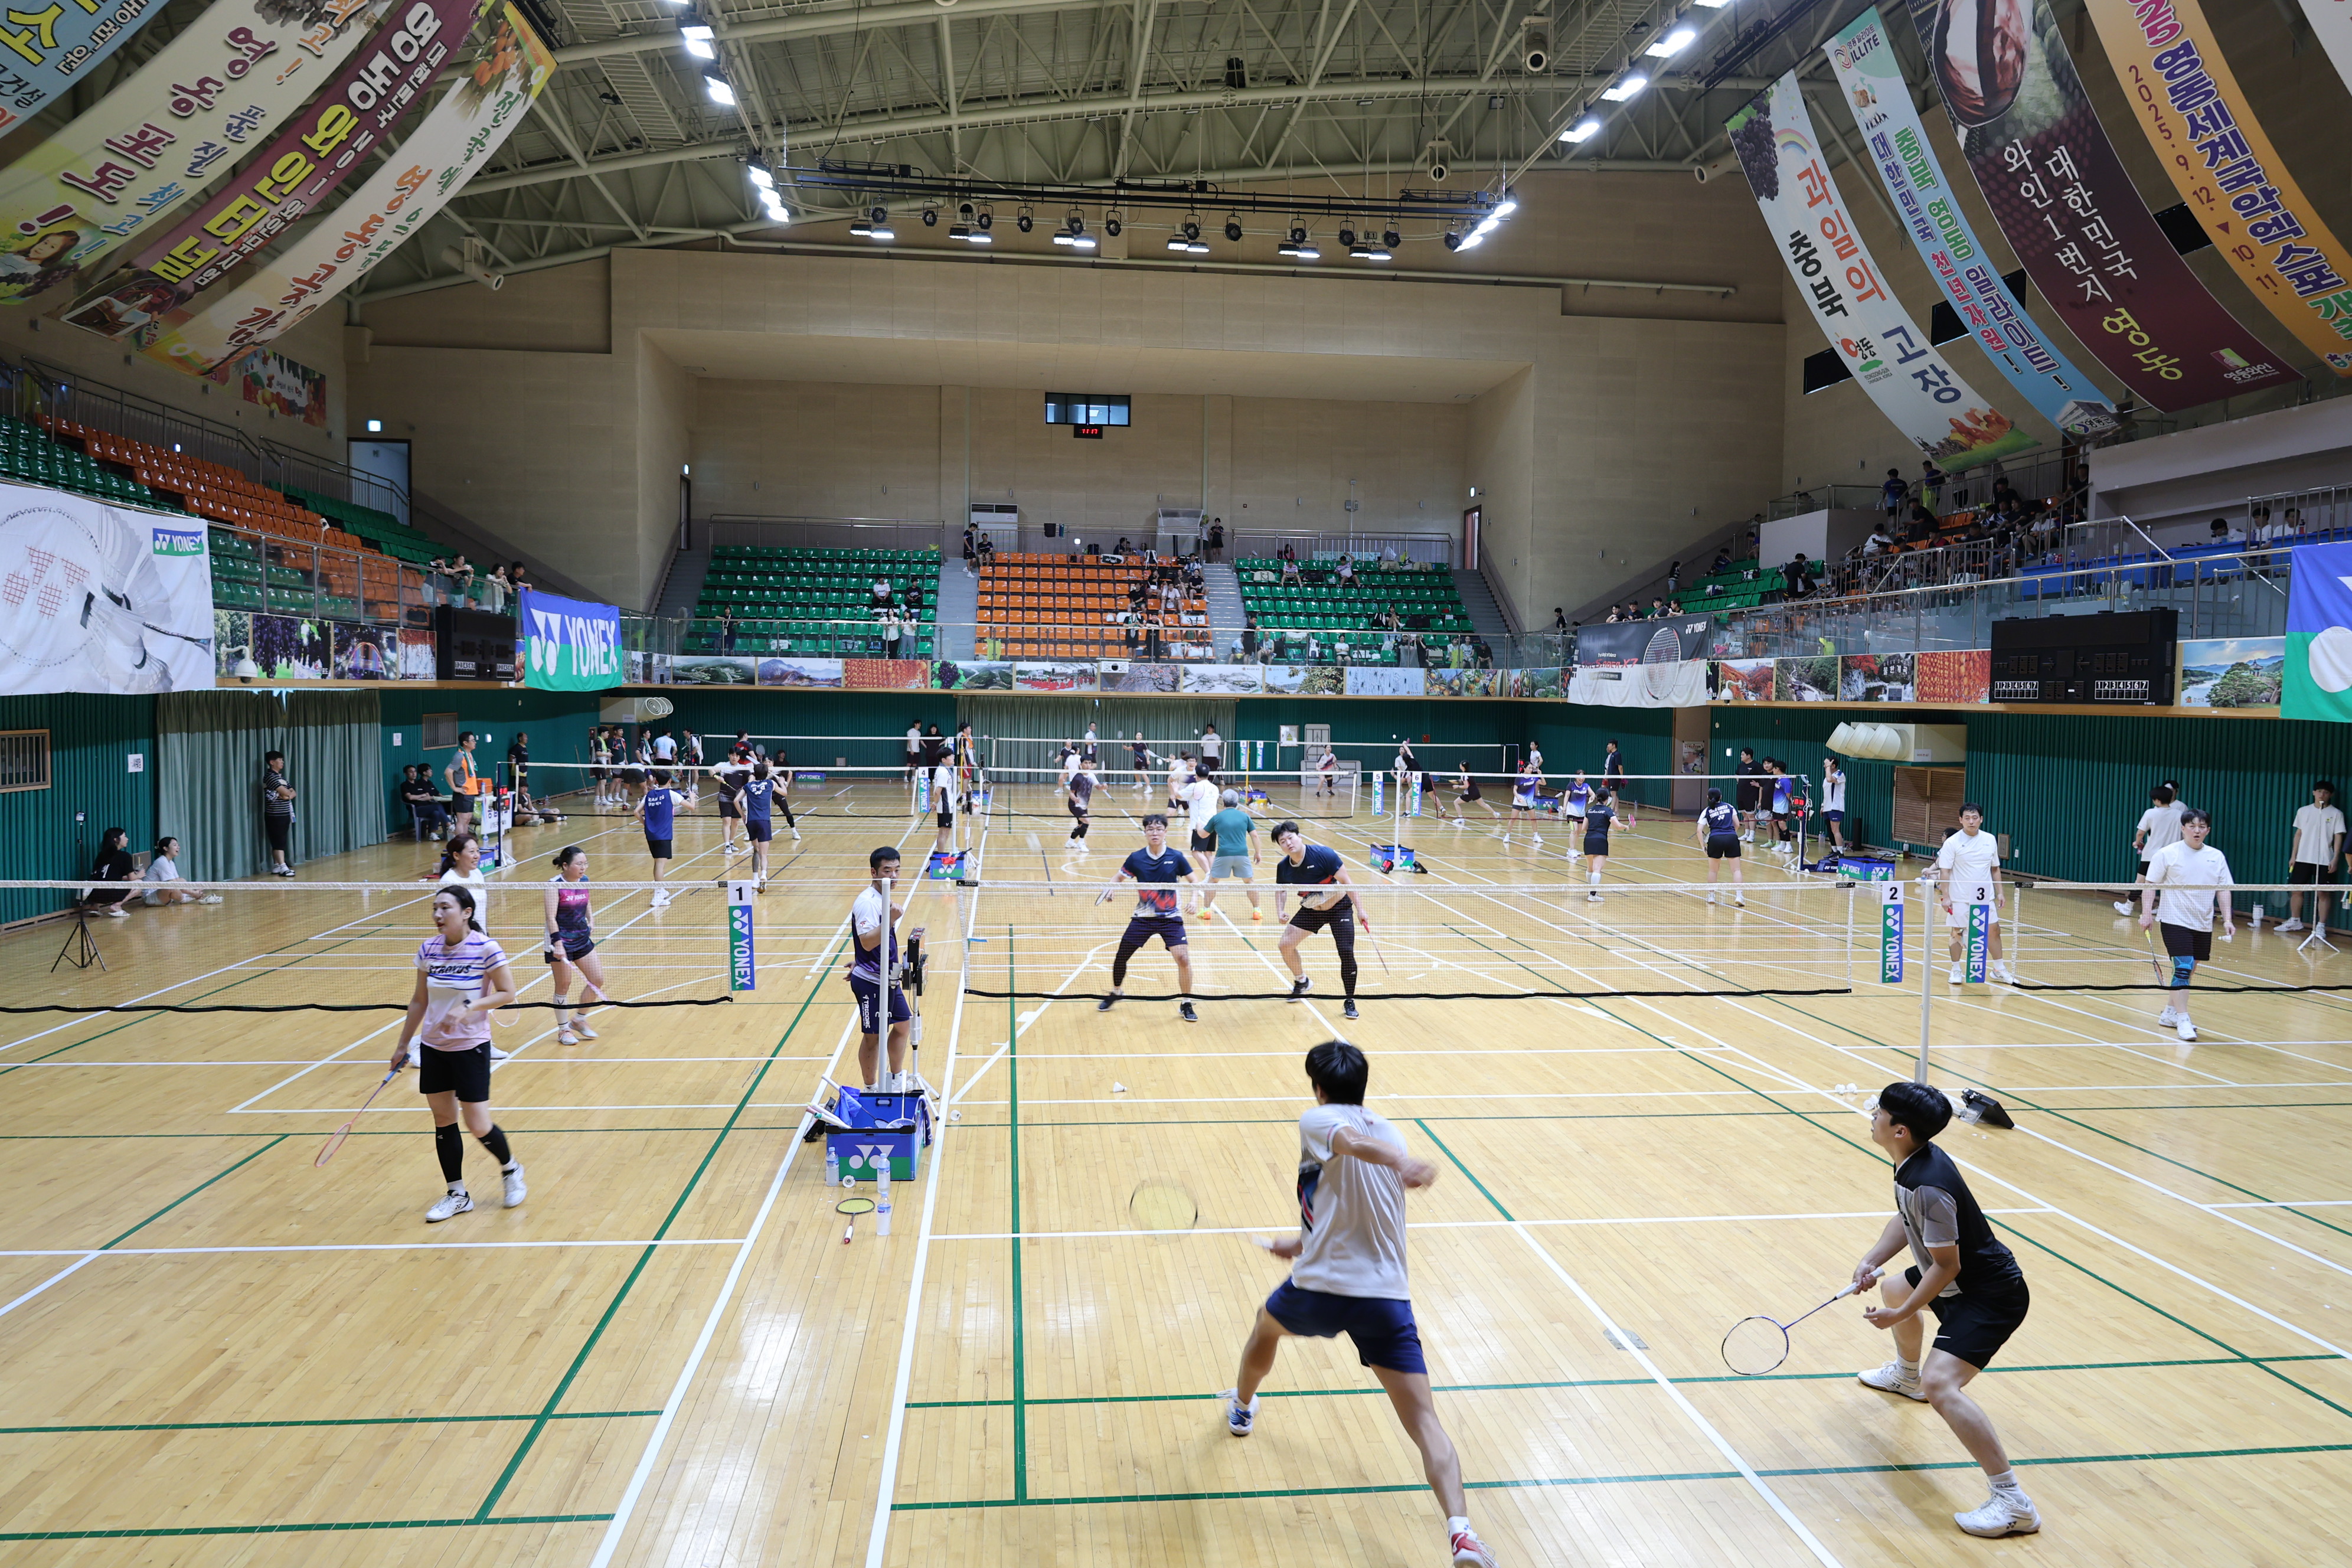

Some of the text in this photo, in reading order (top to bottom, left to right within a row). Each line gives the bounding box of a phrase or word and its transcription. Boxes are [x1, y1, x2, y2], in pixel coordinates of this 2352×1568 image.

[171, 27, 279, 116] 영동
[1850, 33, 1880, 63] ILLITE
[0, 62, 47, 109] 건설
[309, 40, 448, 195] 대한민국 NO.1
[149, 2, 442, 284] 영동 와인터널
[185, 104, 266, 178] 품질
[437, 90, 523, 197] 전국에
[2004, 139, 2053, 208] 와인
[1870, 130, 1936, 242] 대한민국
[1894, 125, 1938, 192] 충북
[1925, 195, 1974, 260] 영동
[2045, 145, 2137, 279] 대한민국
[194, 199, 306, 286] 와인뮤지엄
[1789, 230, 1849, 318] 충북
[1796, 158, 1962, 404] 과일의 고장
[2102, 307, 2183, 380] 영동
[172, 535, 202, 552] YONEX
[565, 615, 617, 677] YONEX
[1693, 620, 1707, 633] YONEX
[1883, 665, 1908, 675] 물한계곡
[736, 886, 743, 901] 1
[1848, 865, 1860, 874] YONEX
[1889, 887, 1897, 900] 2
[1976, 887, 1985, 901] 3
[734, 937, 752, 986] YONEX
[1885, 935, 1900, 979] YONEX
[1968, 935, 1985, 979] YONEX
